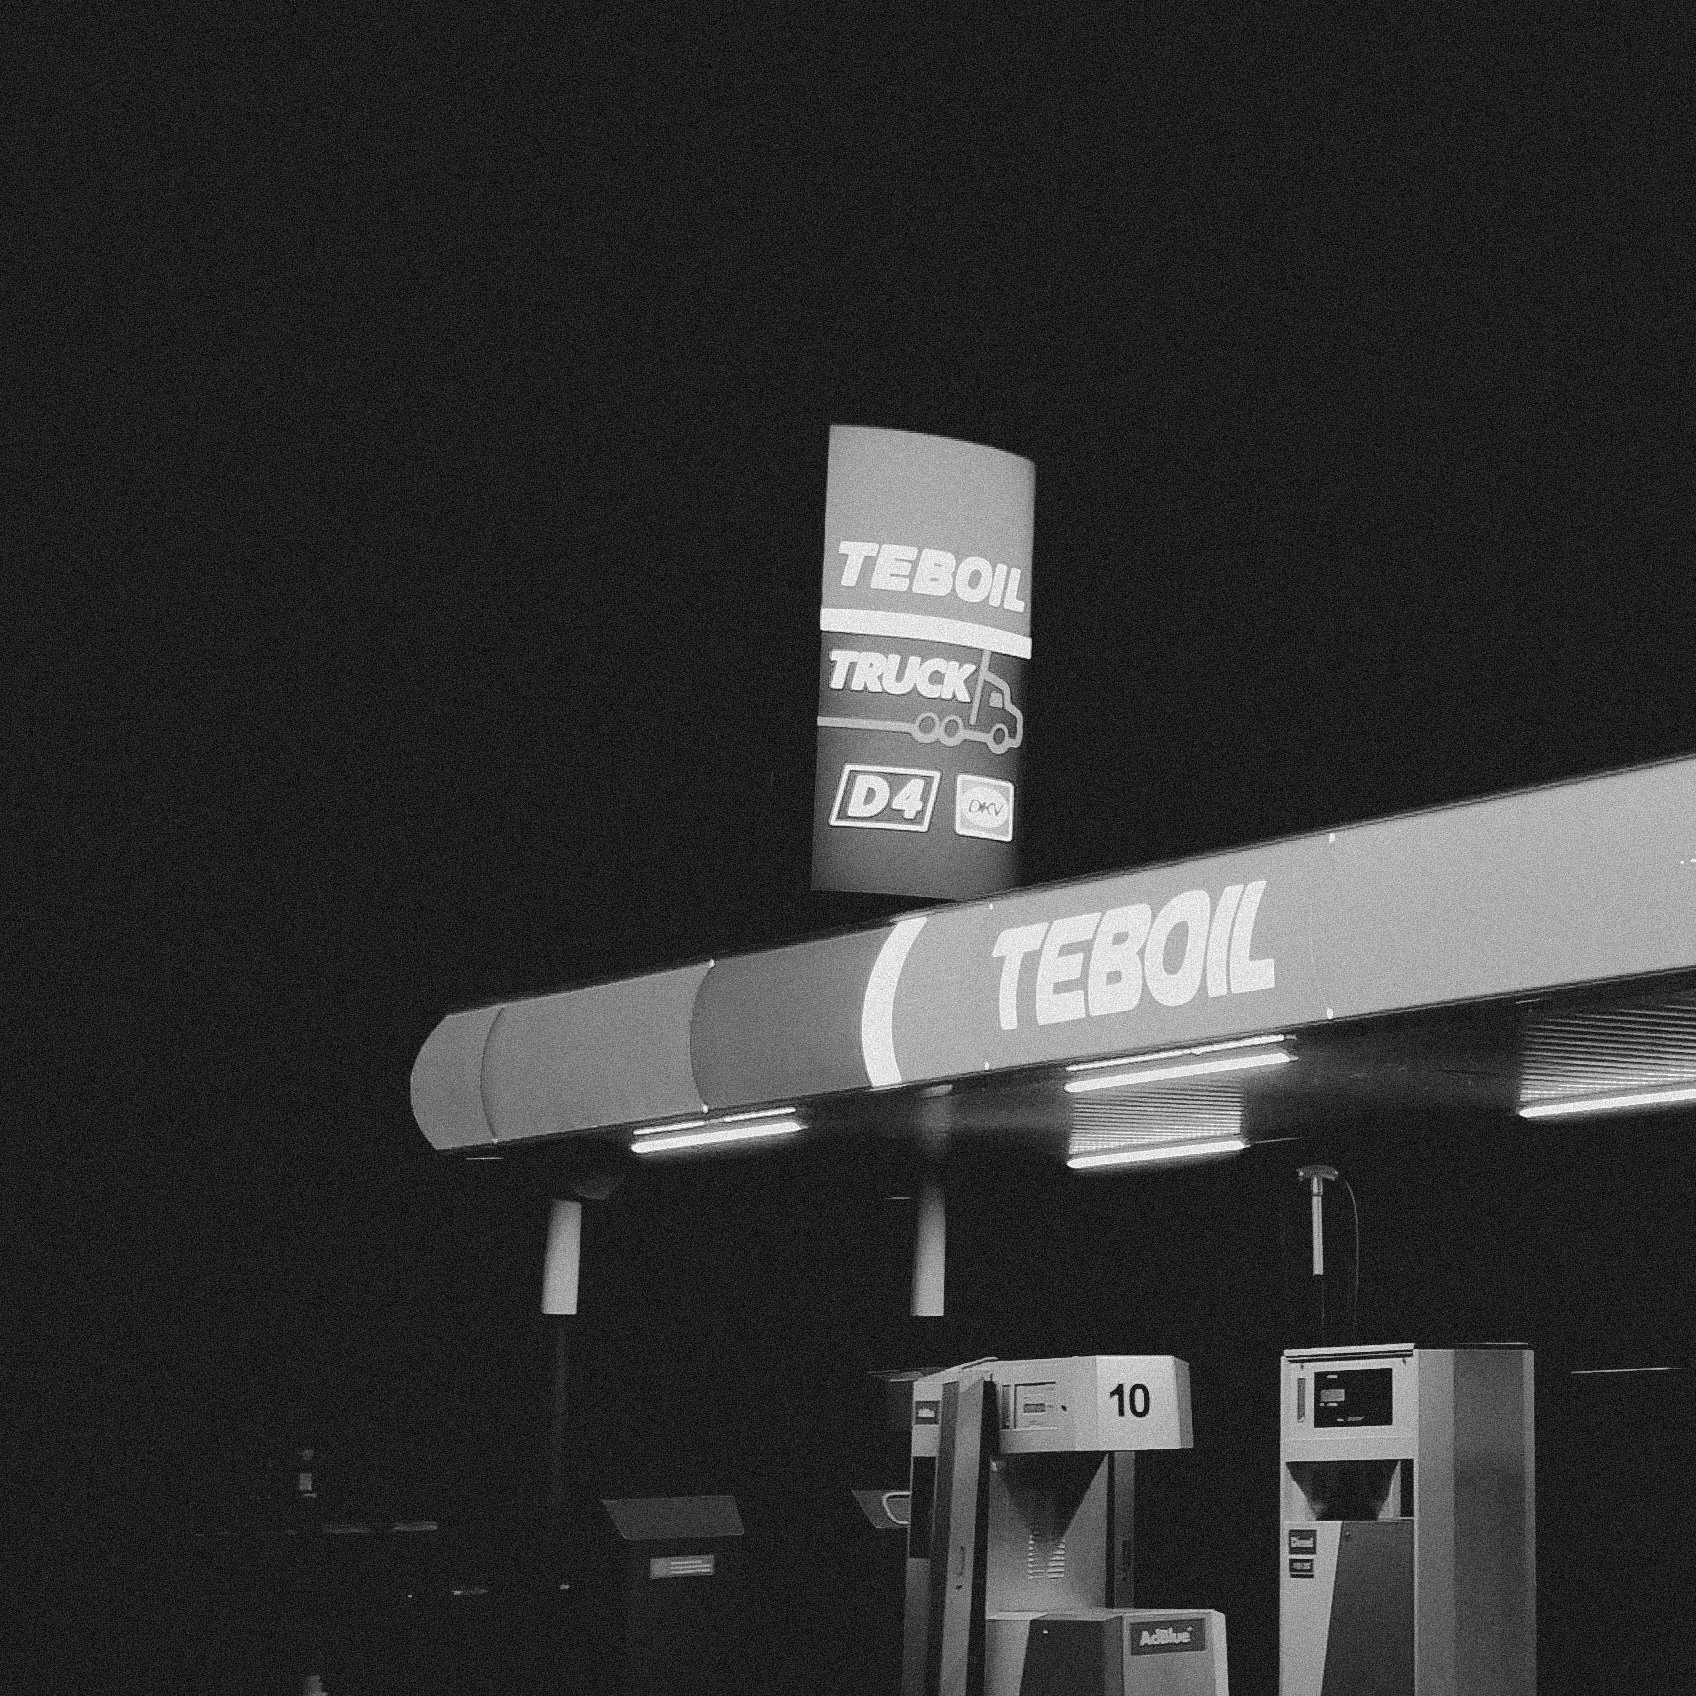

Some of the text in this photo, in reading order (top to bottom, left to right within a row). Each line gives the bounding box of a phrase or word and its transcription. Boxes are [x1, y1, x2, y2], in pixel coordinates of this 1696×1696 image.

[838, 541, 1025, 613] TEBOIL
[829, 649, 977, 703] TRUCK
[847, 774, 925, 820] D4
[968, 798, 1004, 817] DKV
[992, 880, 1276, 1030] TEBOIL
[1109, 1383, 1150, 1418] 10
